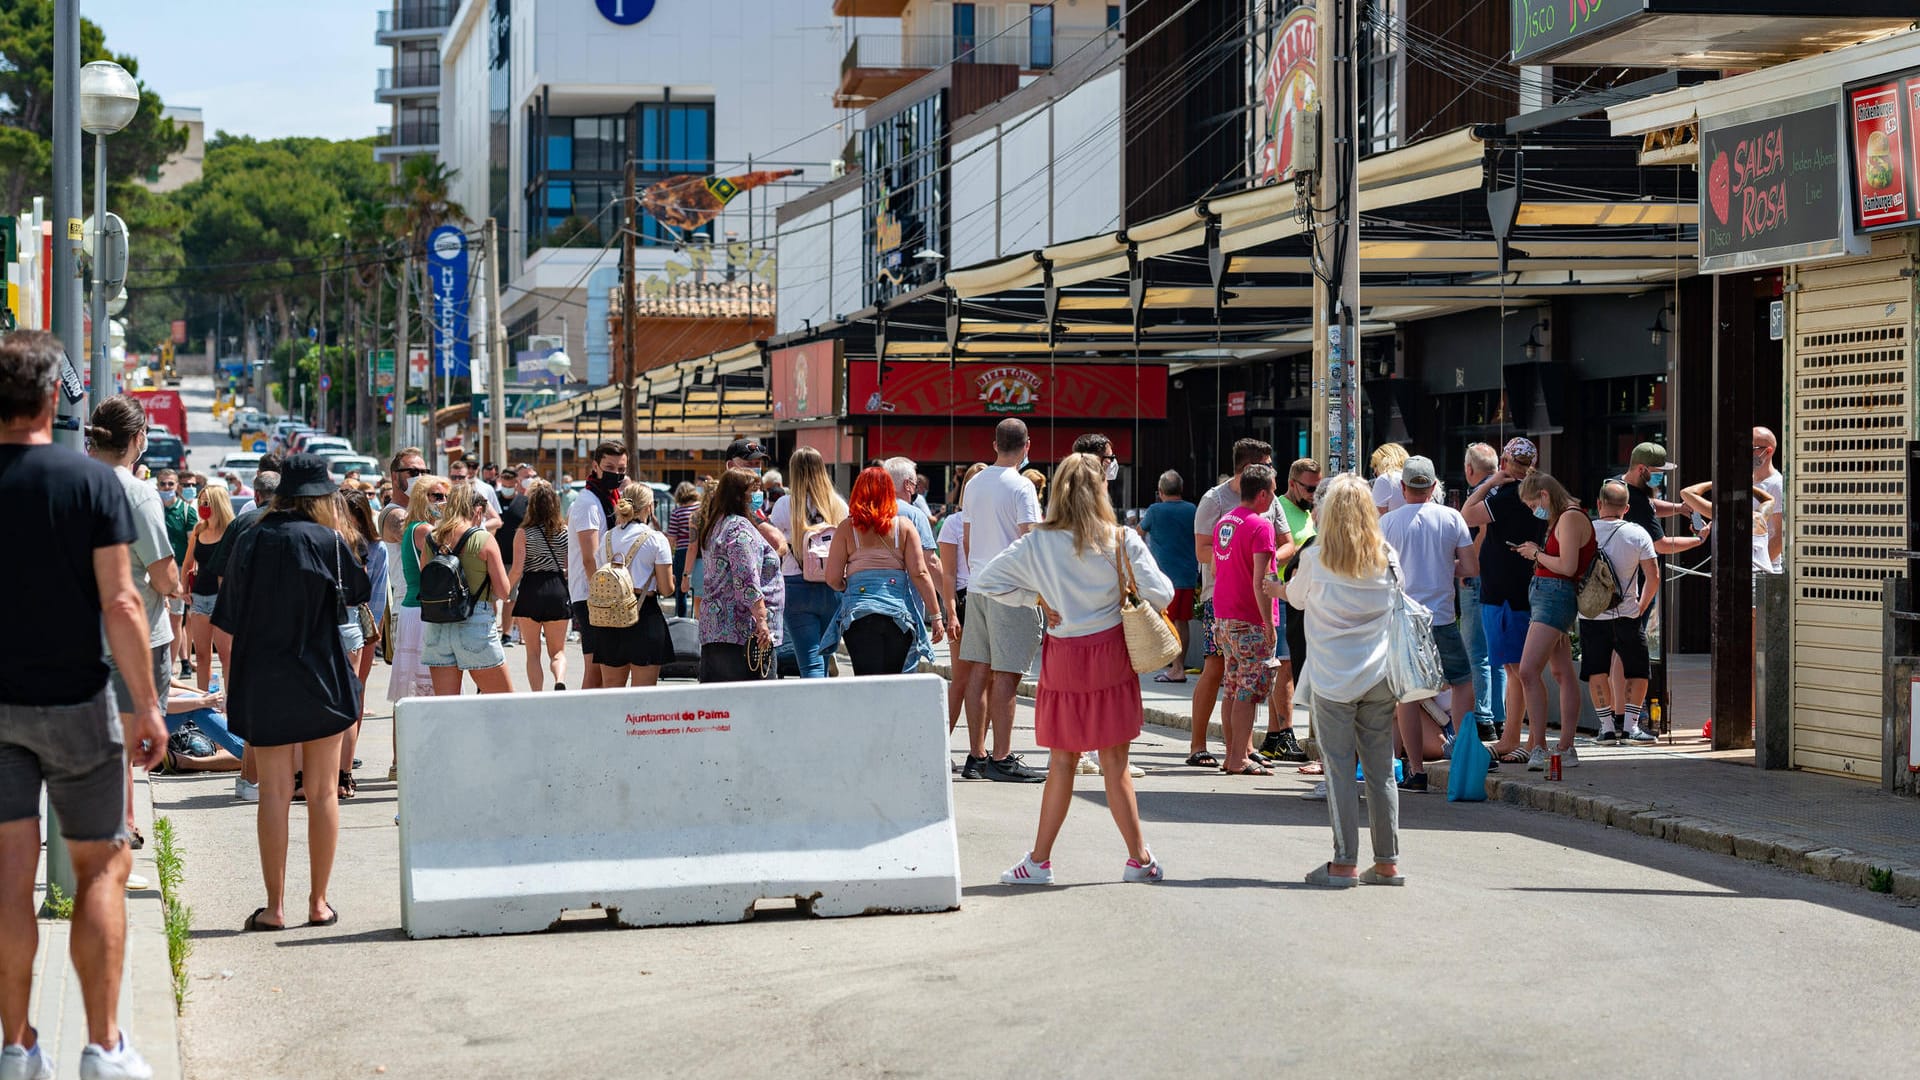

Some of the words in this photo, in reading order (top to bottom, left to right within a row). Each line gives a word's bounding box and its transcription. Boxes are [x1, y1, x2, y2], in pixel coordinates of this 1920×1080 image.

[1732, 124, 1785, 196] SALSA
[1741, 180, 1788, 241] ROSA
[1863, 194, 1893, 212] Hamburger
[1709, 227, 1733, 251] Disco
[976, 368, 1042, 389] BIERKÖNIG
[625, 712, 680, 725] Ajuntament
[681, 710, 695, 721] de
[697, 709, 730, 720] Palma
